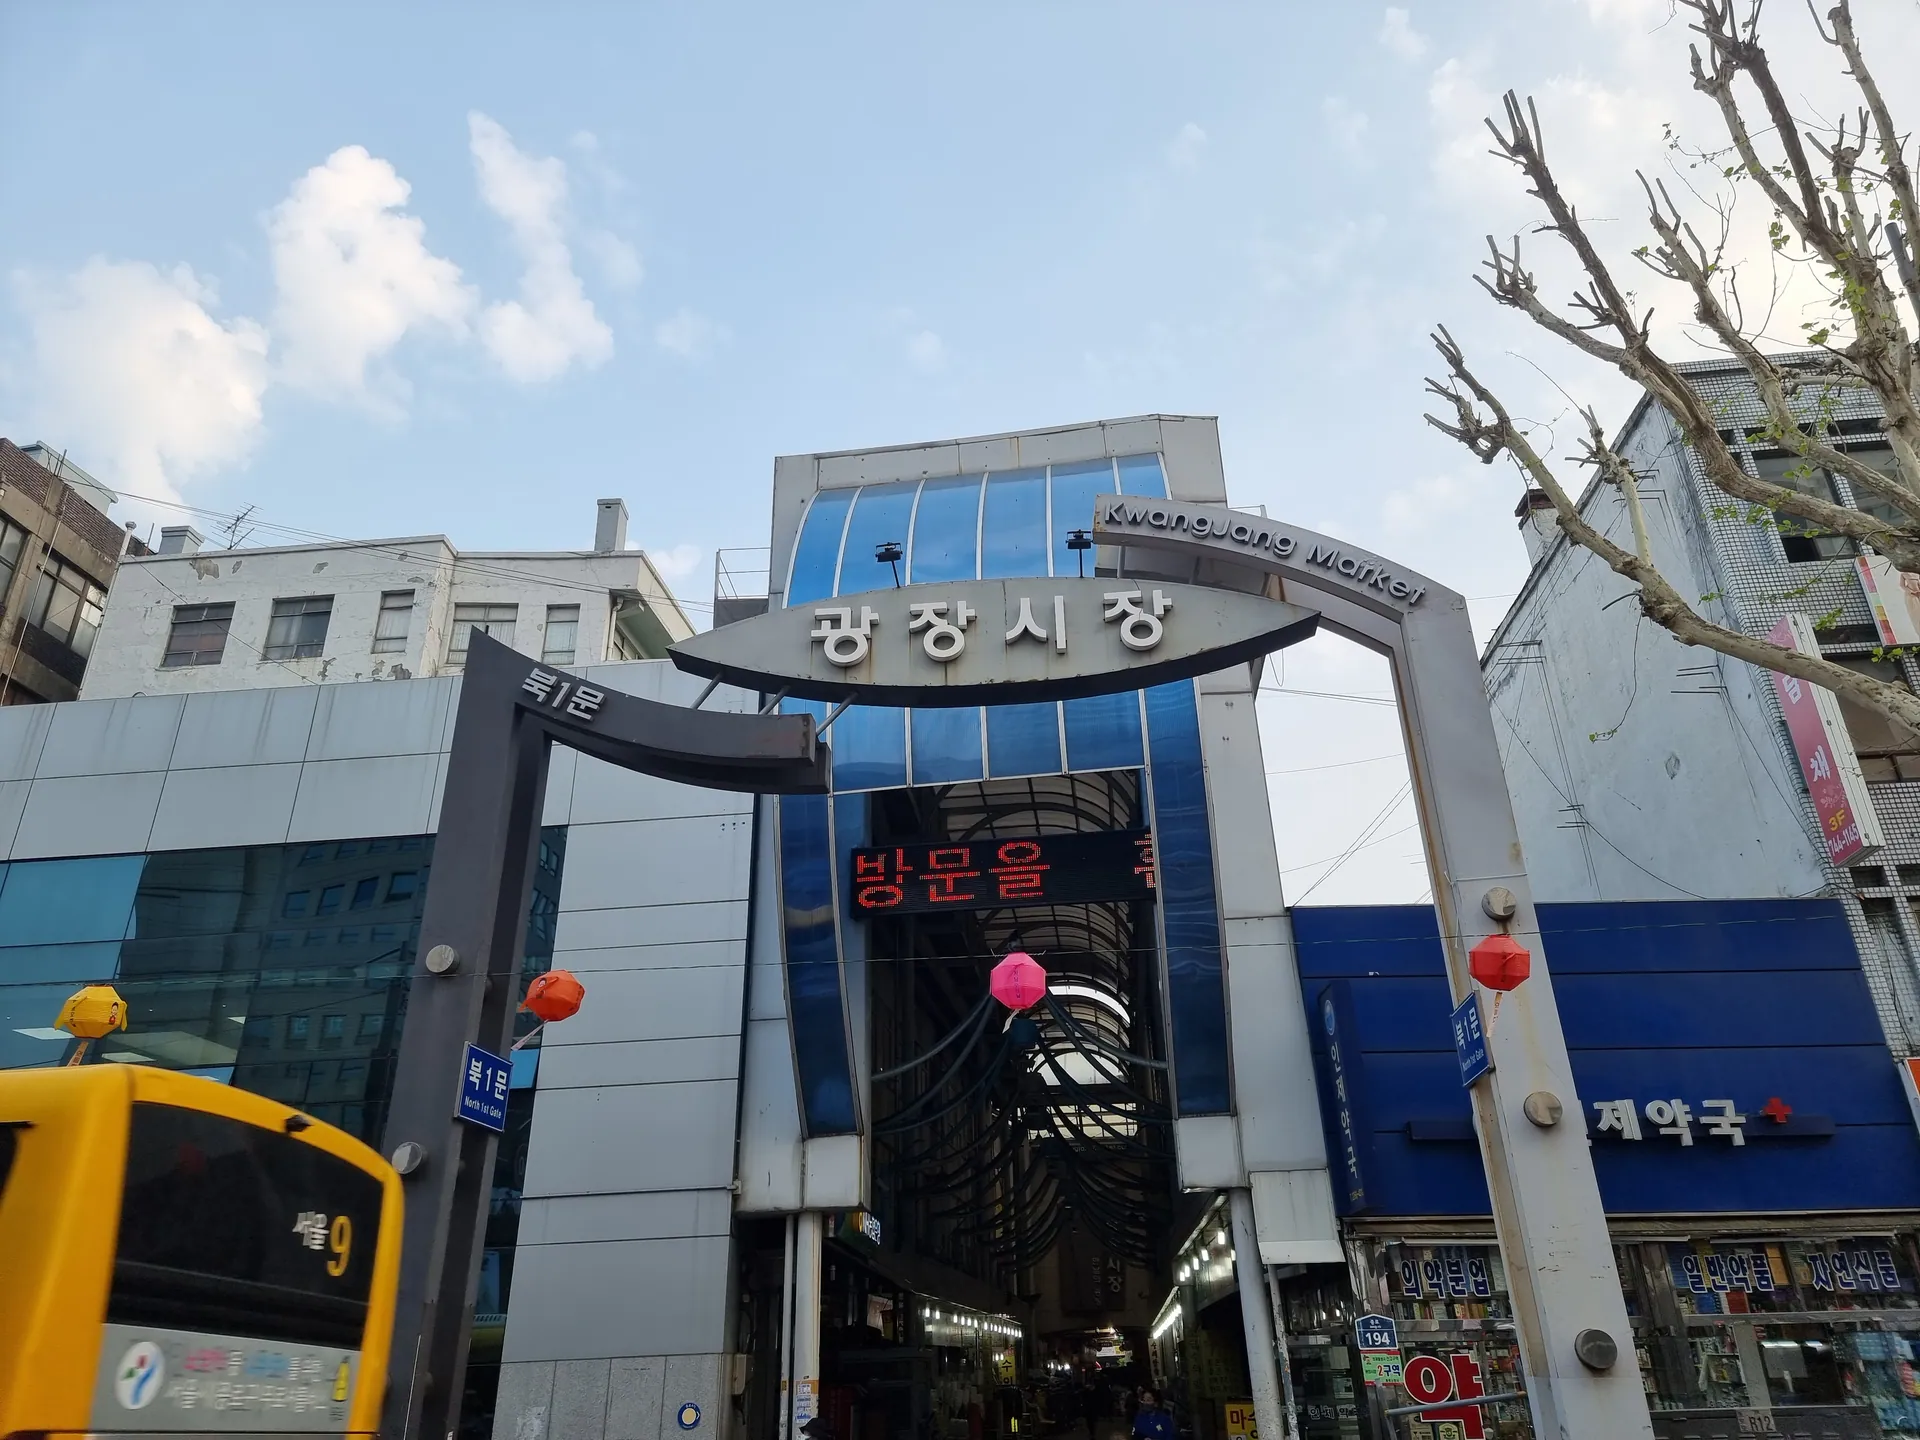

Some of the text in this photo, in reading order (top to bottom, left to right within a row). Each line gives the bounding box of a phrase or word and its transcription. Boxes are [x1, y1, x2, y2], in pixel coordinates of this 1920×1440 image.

[1105, 501, 1427, 606] KwangJang Market
[811, 588, 1174, 669] 광장시장
[1827, 822, 1860, 857] 744-1145
[1828, 809, 1846, 831] 3F
[856, 840, 1051, 910] 방문을
[464, 1095, 480, 1112] North
[489, 1105, 502, 1120] Gate
[1331, 1041, 1359, 1179] 인제약국
[1579, 1098, 1747, 1147] 제약국
[292, 1211, 352, 1277] 서울 9
[1400, 1257, 1492, 1300] 의약분업
[1682, 1253, 1776, 1294] 일반약품
[1806, 1250, 1902, 1292] 자연식품
[1365, 1332, 1391, 1346] 194
[1404, 1354, 1486, 1440] 약
